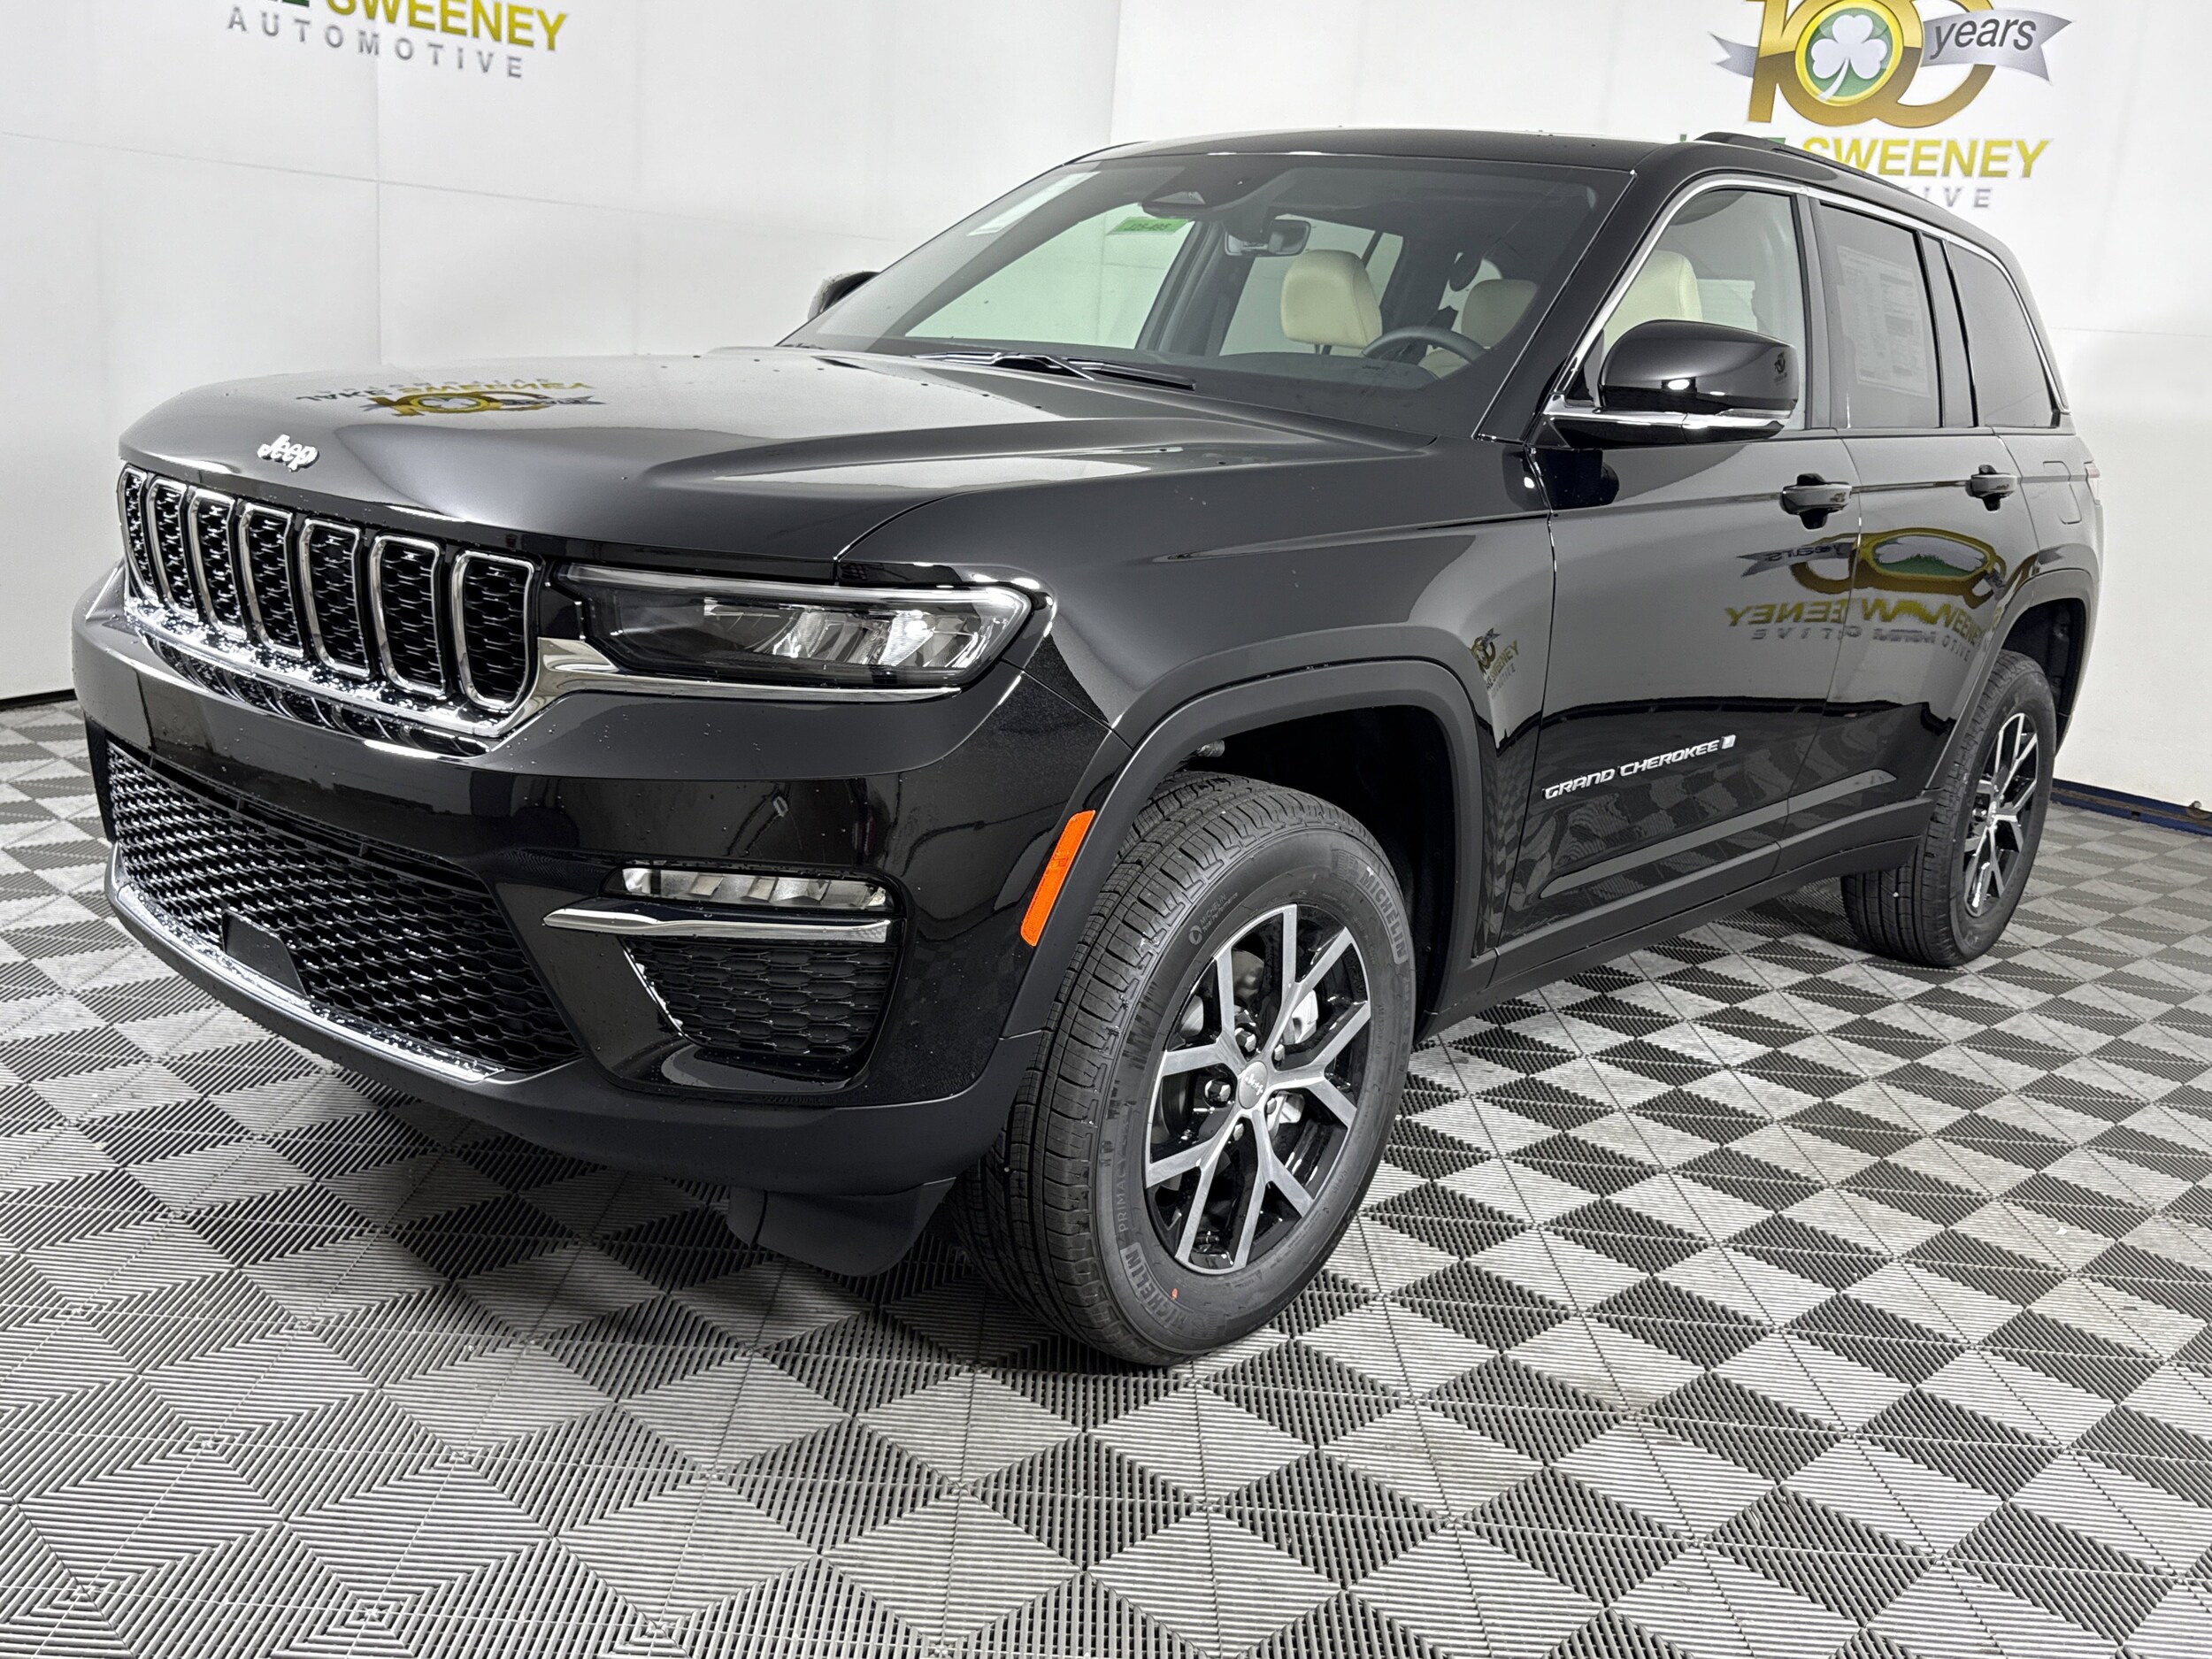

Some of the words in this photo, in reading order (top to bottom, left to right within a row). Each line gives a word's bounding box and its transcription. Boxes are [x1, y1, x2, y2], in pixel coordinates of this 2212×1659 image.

[227, 6, 524, 79] AUTOMOTIVE
[1929, 18, 2037, 60] years
[257, 434, 319, 472] Jeep
[1544, 767, 1616, 800] GRAND
[1617, 739, 1720, 779] CHEROKEE
[1200, 893, 1227, 926] MICHELIN
[1359, 865, 1408, 958] MICHELIN
[1116, 1156, 1129, 1233] PRIMACY
[1125, 1248, 1189, 1329] MICHELIN
